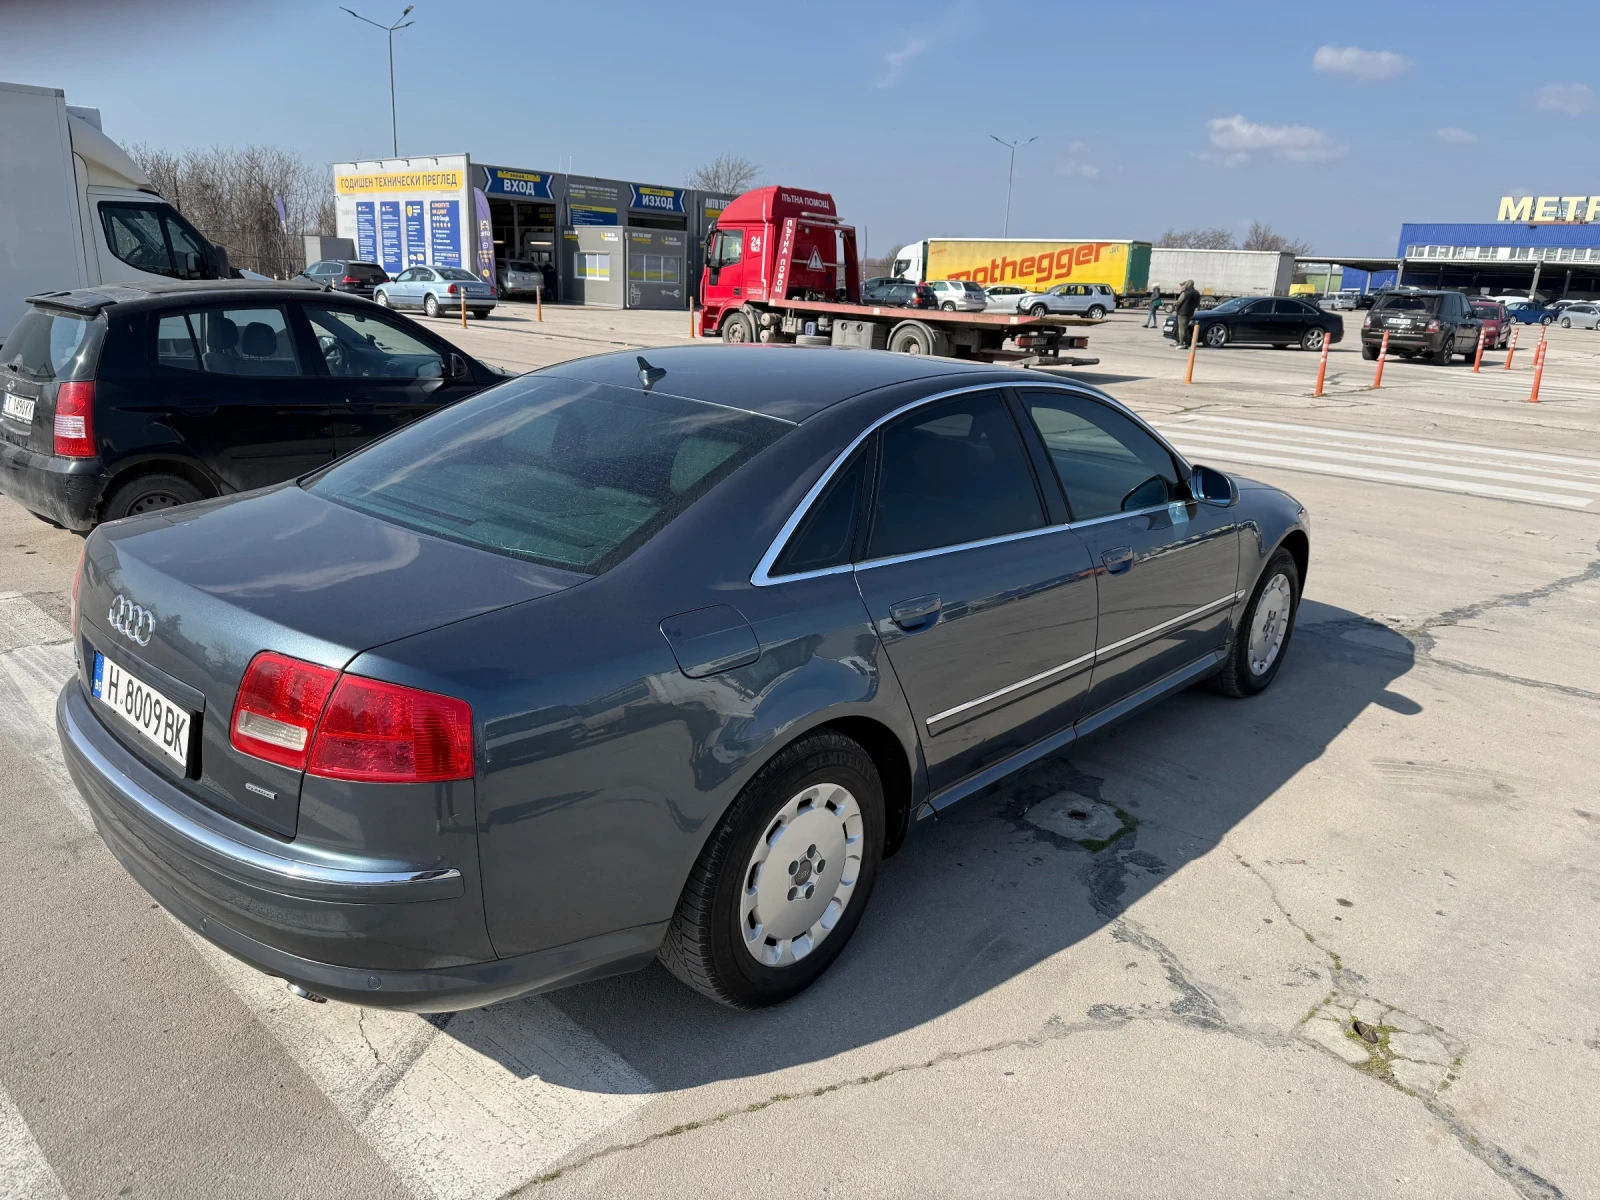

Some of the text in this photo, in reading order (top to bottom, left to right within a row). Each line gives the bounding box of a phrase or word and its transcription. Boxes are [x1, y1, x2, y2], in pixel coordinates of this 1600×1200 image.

[341, 174, 458, 190] ГОДИШЕН ТЕХНИЧЕСКИ ПРЕГЛЕД
[504, 179, 535, 196] ВХОД
[642, 194, 674, 210] ИЗХОД
[705, 198, 718, 209] AUTO
[782, 192, 830, 210] ПЪТНА ПОМОЩ
[750, 236, 761, 245] 24
[774, 220, 792, 293] ПЪТНА ПОМОЩ
